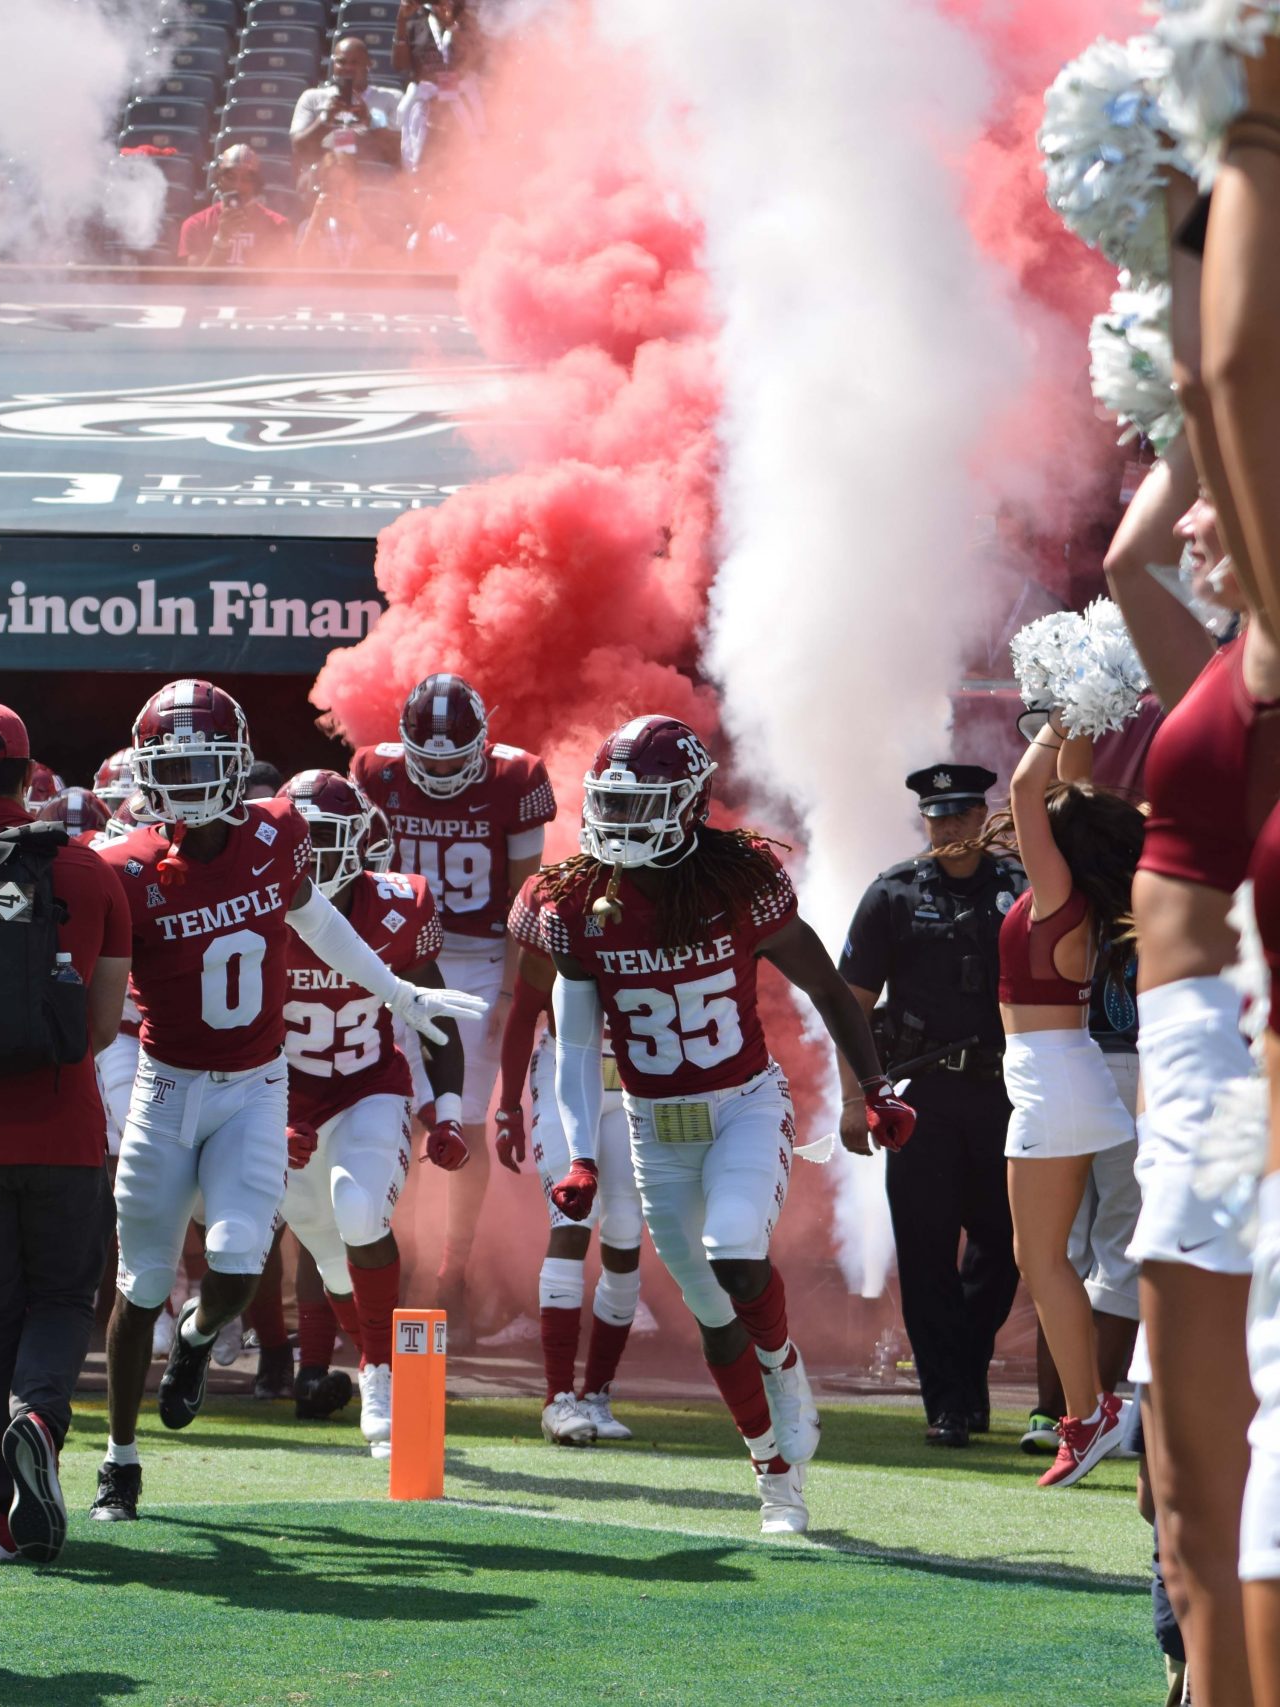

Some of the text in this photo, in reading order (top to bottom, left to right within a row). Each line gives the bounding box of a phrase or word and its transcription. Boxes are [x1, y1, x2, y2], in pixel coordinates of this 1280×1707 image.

[205, 306, 468, 322] Linc
[136, 494, 420, 509] Financial
[209, 580, 387, 638] Finan
[178, 735, 192, 744] 215
[677, 735, 710, 773] 35
[609, 771, 623, 781] 215
[391, 815, 490, 838] TEMPLE
[398, 838, 492, 914] 49
[155, 883, 282, 940] TEMPLE
[596, 935, 735, 976] TEMPLE
[201, 929, 266, 1030] 0
[283, 995, 382, 1079] 23
[613, 969, 745, 1077] 35
[400, 1322, 424, 1353] T
[434, 1322, 446, 1353] T
